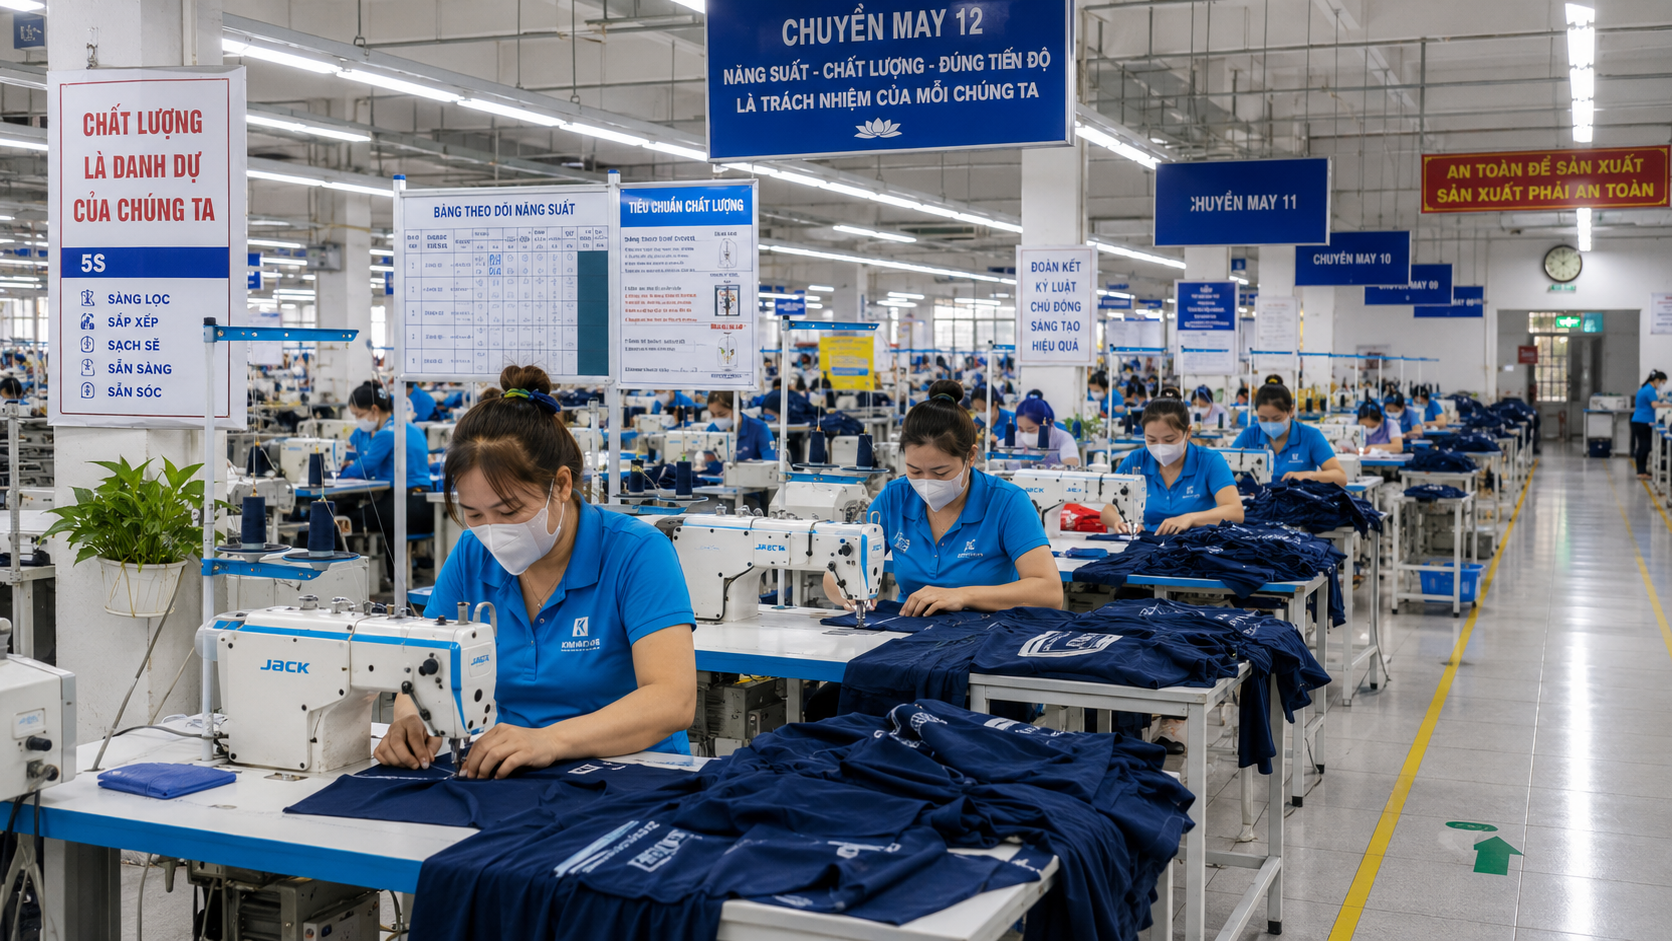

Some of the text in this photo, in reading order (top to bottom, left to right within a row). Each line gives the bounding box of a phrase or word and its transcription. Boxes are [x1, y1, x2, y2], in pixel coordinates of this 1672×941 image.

[893, 9, 947, 39] MAY
[955, 7, 983, 35] 12
[724, 64, 766, 85] NĂNG
[770, 59, 809, 81] SUẤT
[823, 55, 865, 79] CHẤT
[870, 57, 924, 80] LƯỢNG
[939, 52, 984, 72] ĐÚNG
[988, 47, 1022, 70] TIẾN
[1027, 46, 1050, 72] ĐỘ
[737, 80, 1039, 113] LÀ TRÁCH NHIỆM CỦA MỖI CHÚNG TA
[83, 103, 202, 139] CHẤT LƯỢNG
[85, 151, 202, 183] LÀ DANH DỰ
[1447, 154, 1644, 179] AN TOÀN ĐỂ SẢN XUẤT
[1437, 179, 1654, 203] SẢN XUẤT PHẢI AN TOÀN
[74, 191, 215, 222] CỦA CHÚNG TA
[464, 205, 491, 217] THEO
[515, 202, 545, 216] NĂNG
[712, 198, 744, 214] LƯỢNG
[1247, 194, 1278, 210] MAY
[1283, 194, 1296, 210] 11
[81, 253, 106, 272] 5S
[1356, 253, 1376, 264] MAY
[1380, 253, 1391, 264] 10
[108, 291, 170, 307] SÀNG LỌC
[1061, 320, 1080, 334] TẠO
[108, 340, 141, 353] SẠCH
[136, 361, 172, 374] SÀNG
[136, 384, 162, 397] SÓC
[260, 659, 310, 674] JACK
